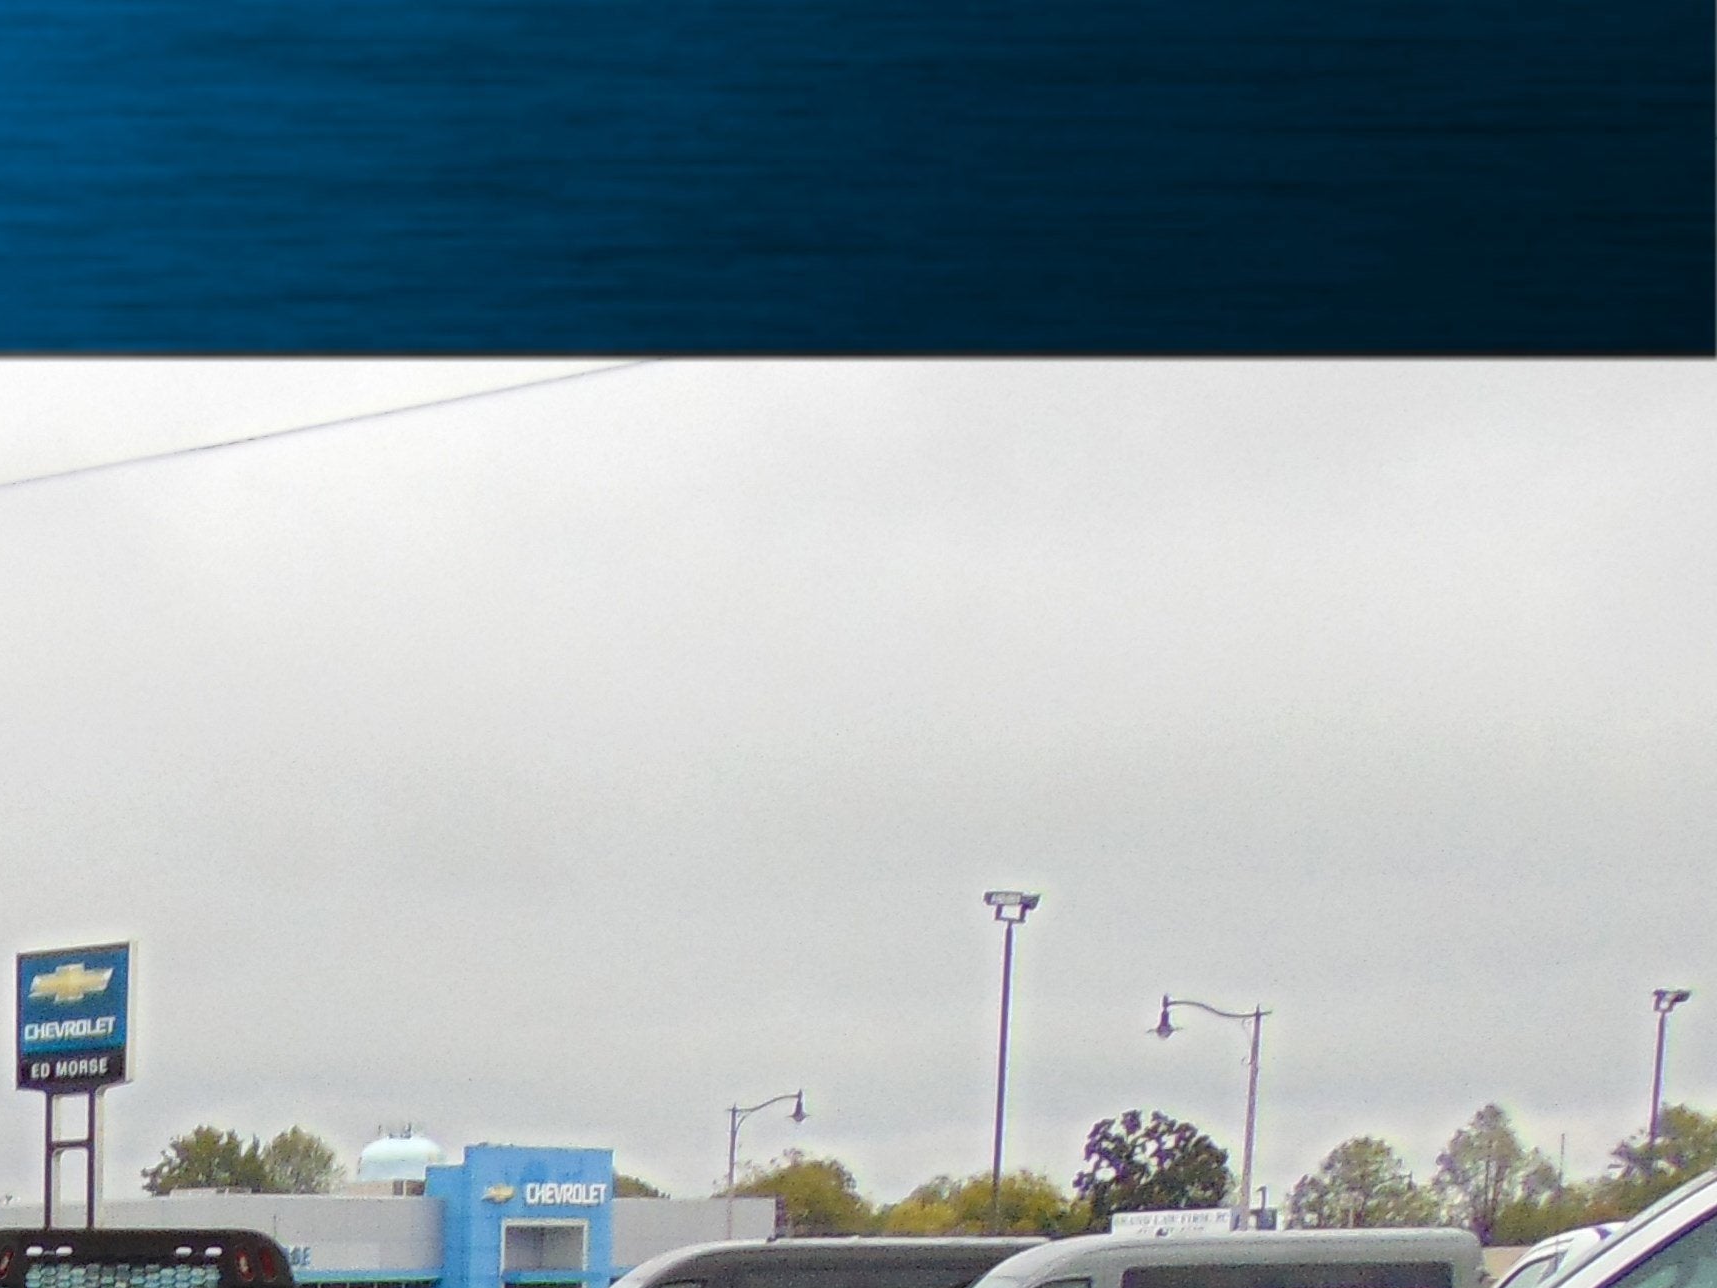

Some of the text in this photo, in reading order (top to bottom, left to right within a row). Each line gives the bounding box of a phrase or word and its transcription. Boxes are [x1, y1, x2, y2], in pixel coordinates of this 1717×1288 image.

[24, 1016, 116, 1041] CHEVROLET
[31, 1057, 110, 1079] ED MORSE
[525, 1182, 607, 1206] CHEVROLET
